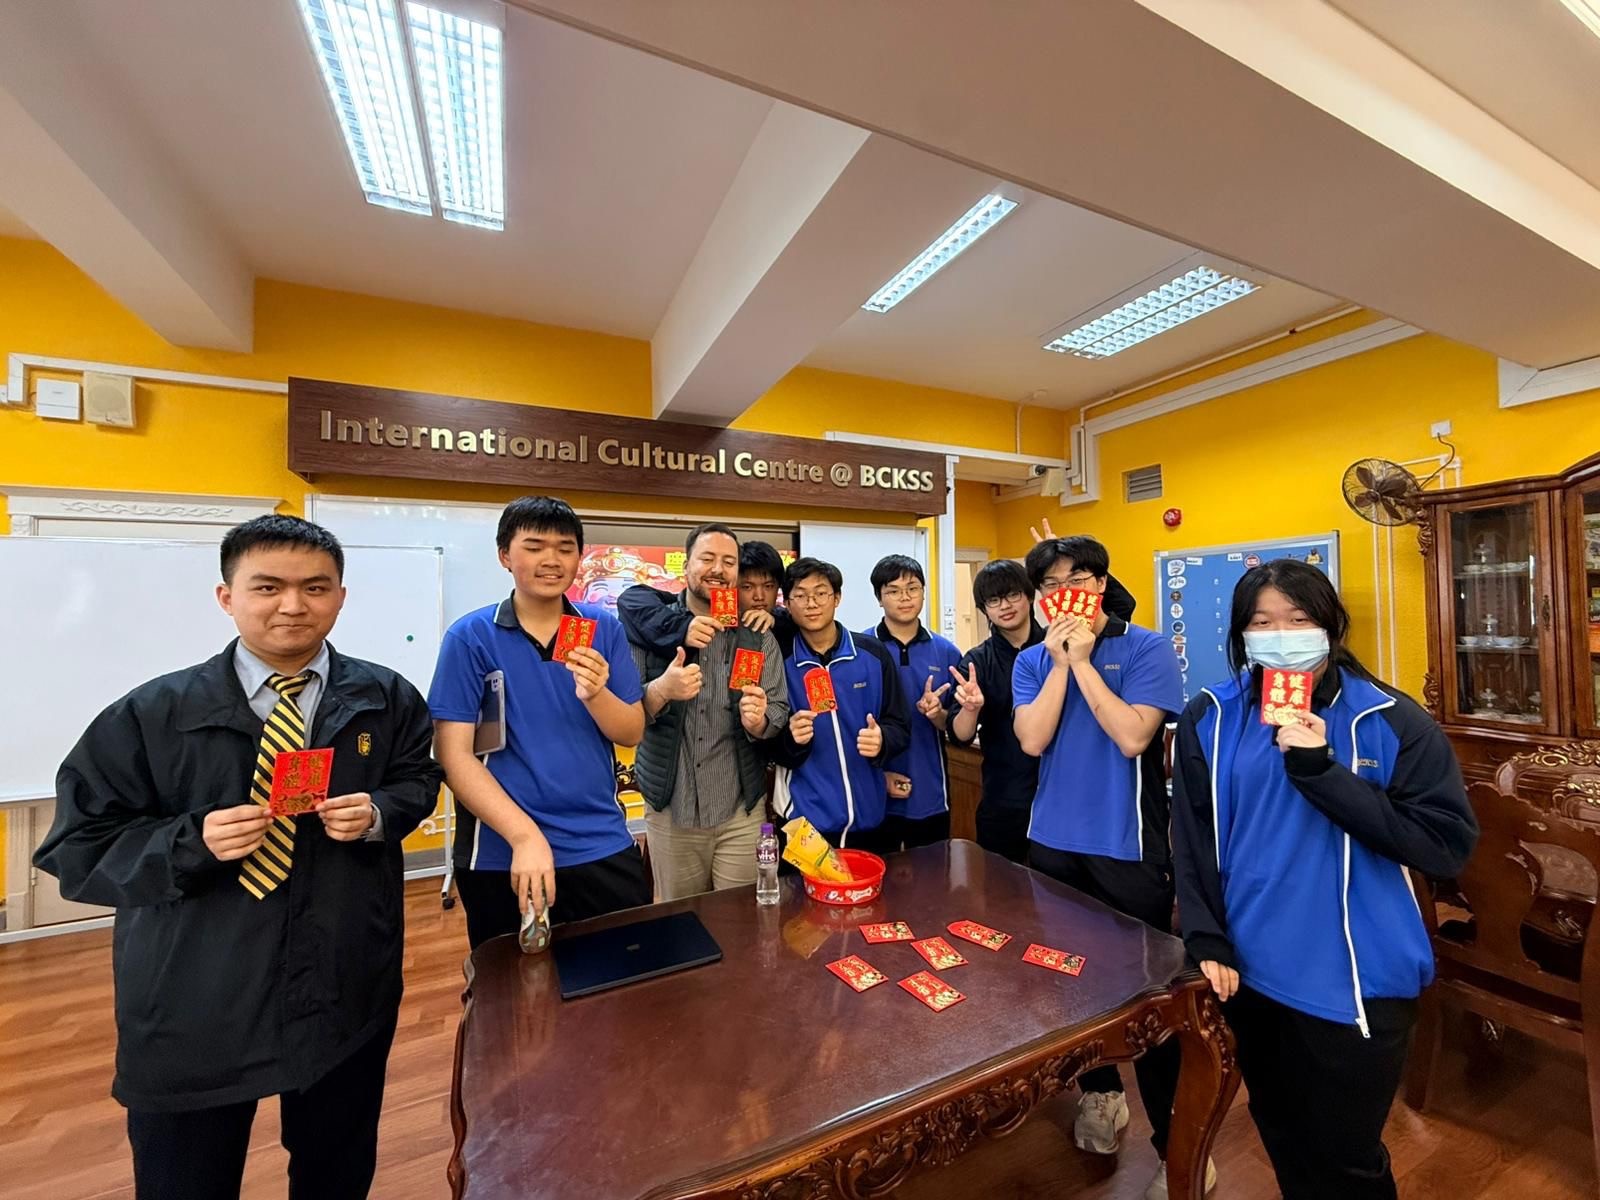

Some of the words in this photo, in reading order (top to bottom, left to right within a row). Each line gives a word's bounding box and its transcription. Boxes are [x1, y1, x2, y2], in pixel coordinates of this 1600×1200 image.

[319, 409, 589, 463] International
[597, 438, 727, 475] Cultural
[733, 451, 825, 484] Centre
[830, 461, 853, 488] @
[859, 464, 935, 493] BCKSS
